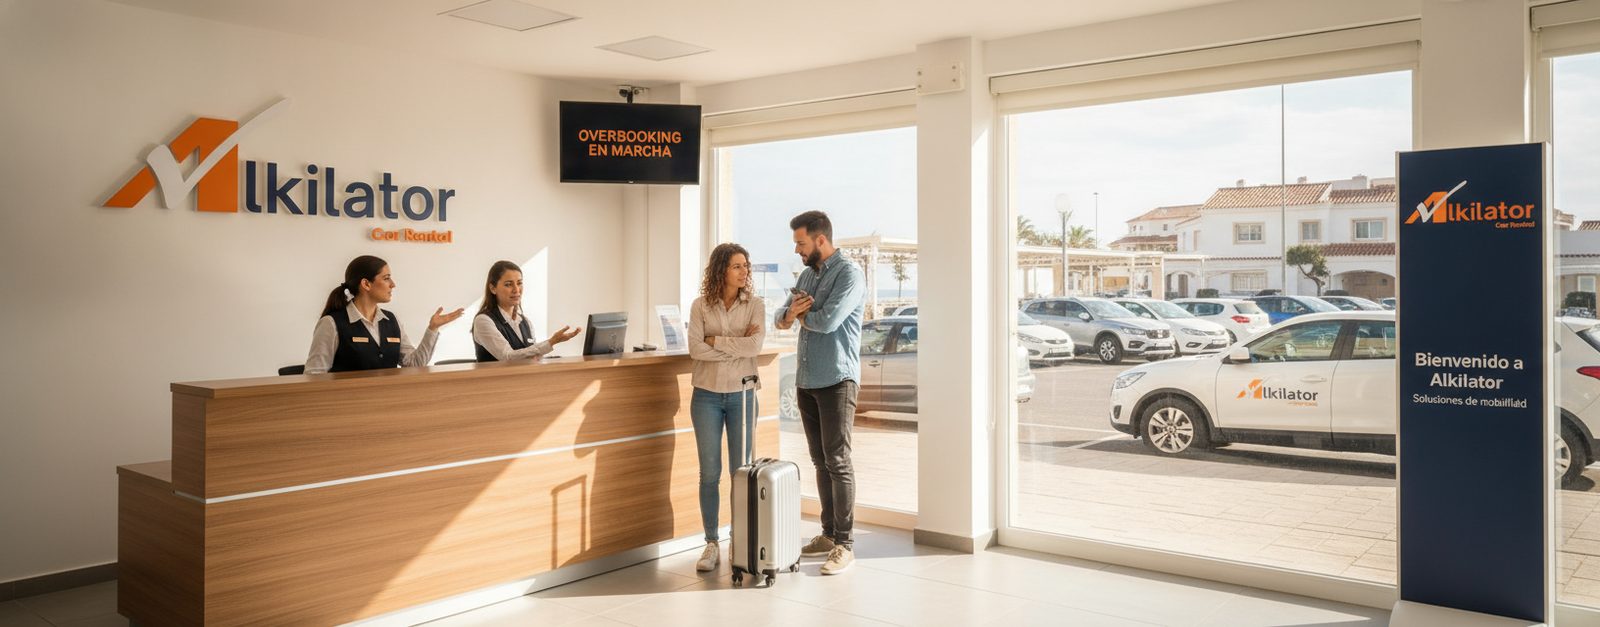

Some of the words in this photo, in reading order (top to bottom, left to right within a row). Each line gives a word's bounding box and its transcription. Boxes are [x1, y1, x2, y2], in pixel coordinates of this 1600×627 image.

[578, 129, 682, 143] OVERBOOKING
[588, 144, 608, 156] EN
[611, 145, 672, 158] MARCHA
[1415, 352, 1509, 369] Bienvenido
[1513, 358, 1524, 370] a
[1430, 373, 1504, 389] Alkilator
[1465, 396, 1478, 406] de
